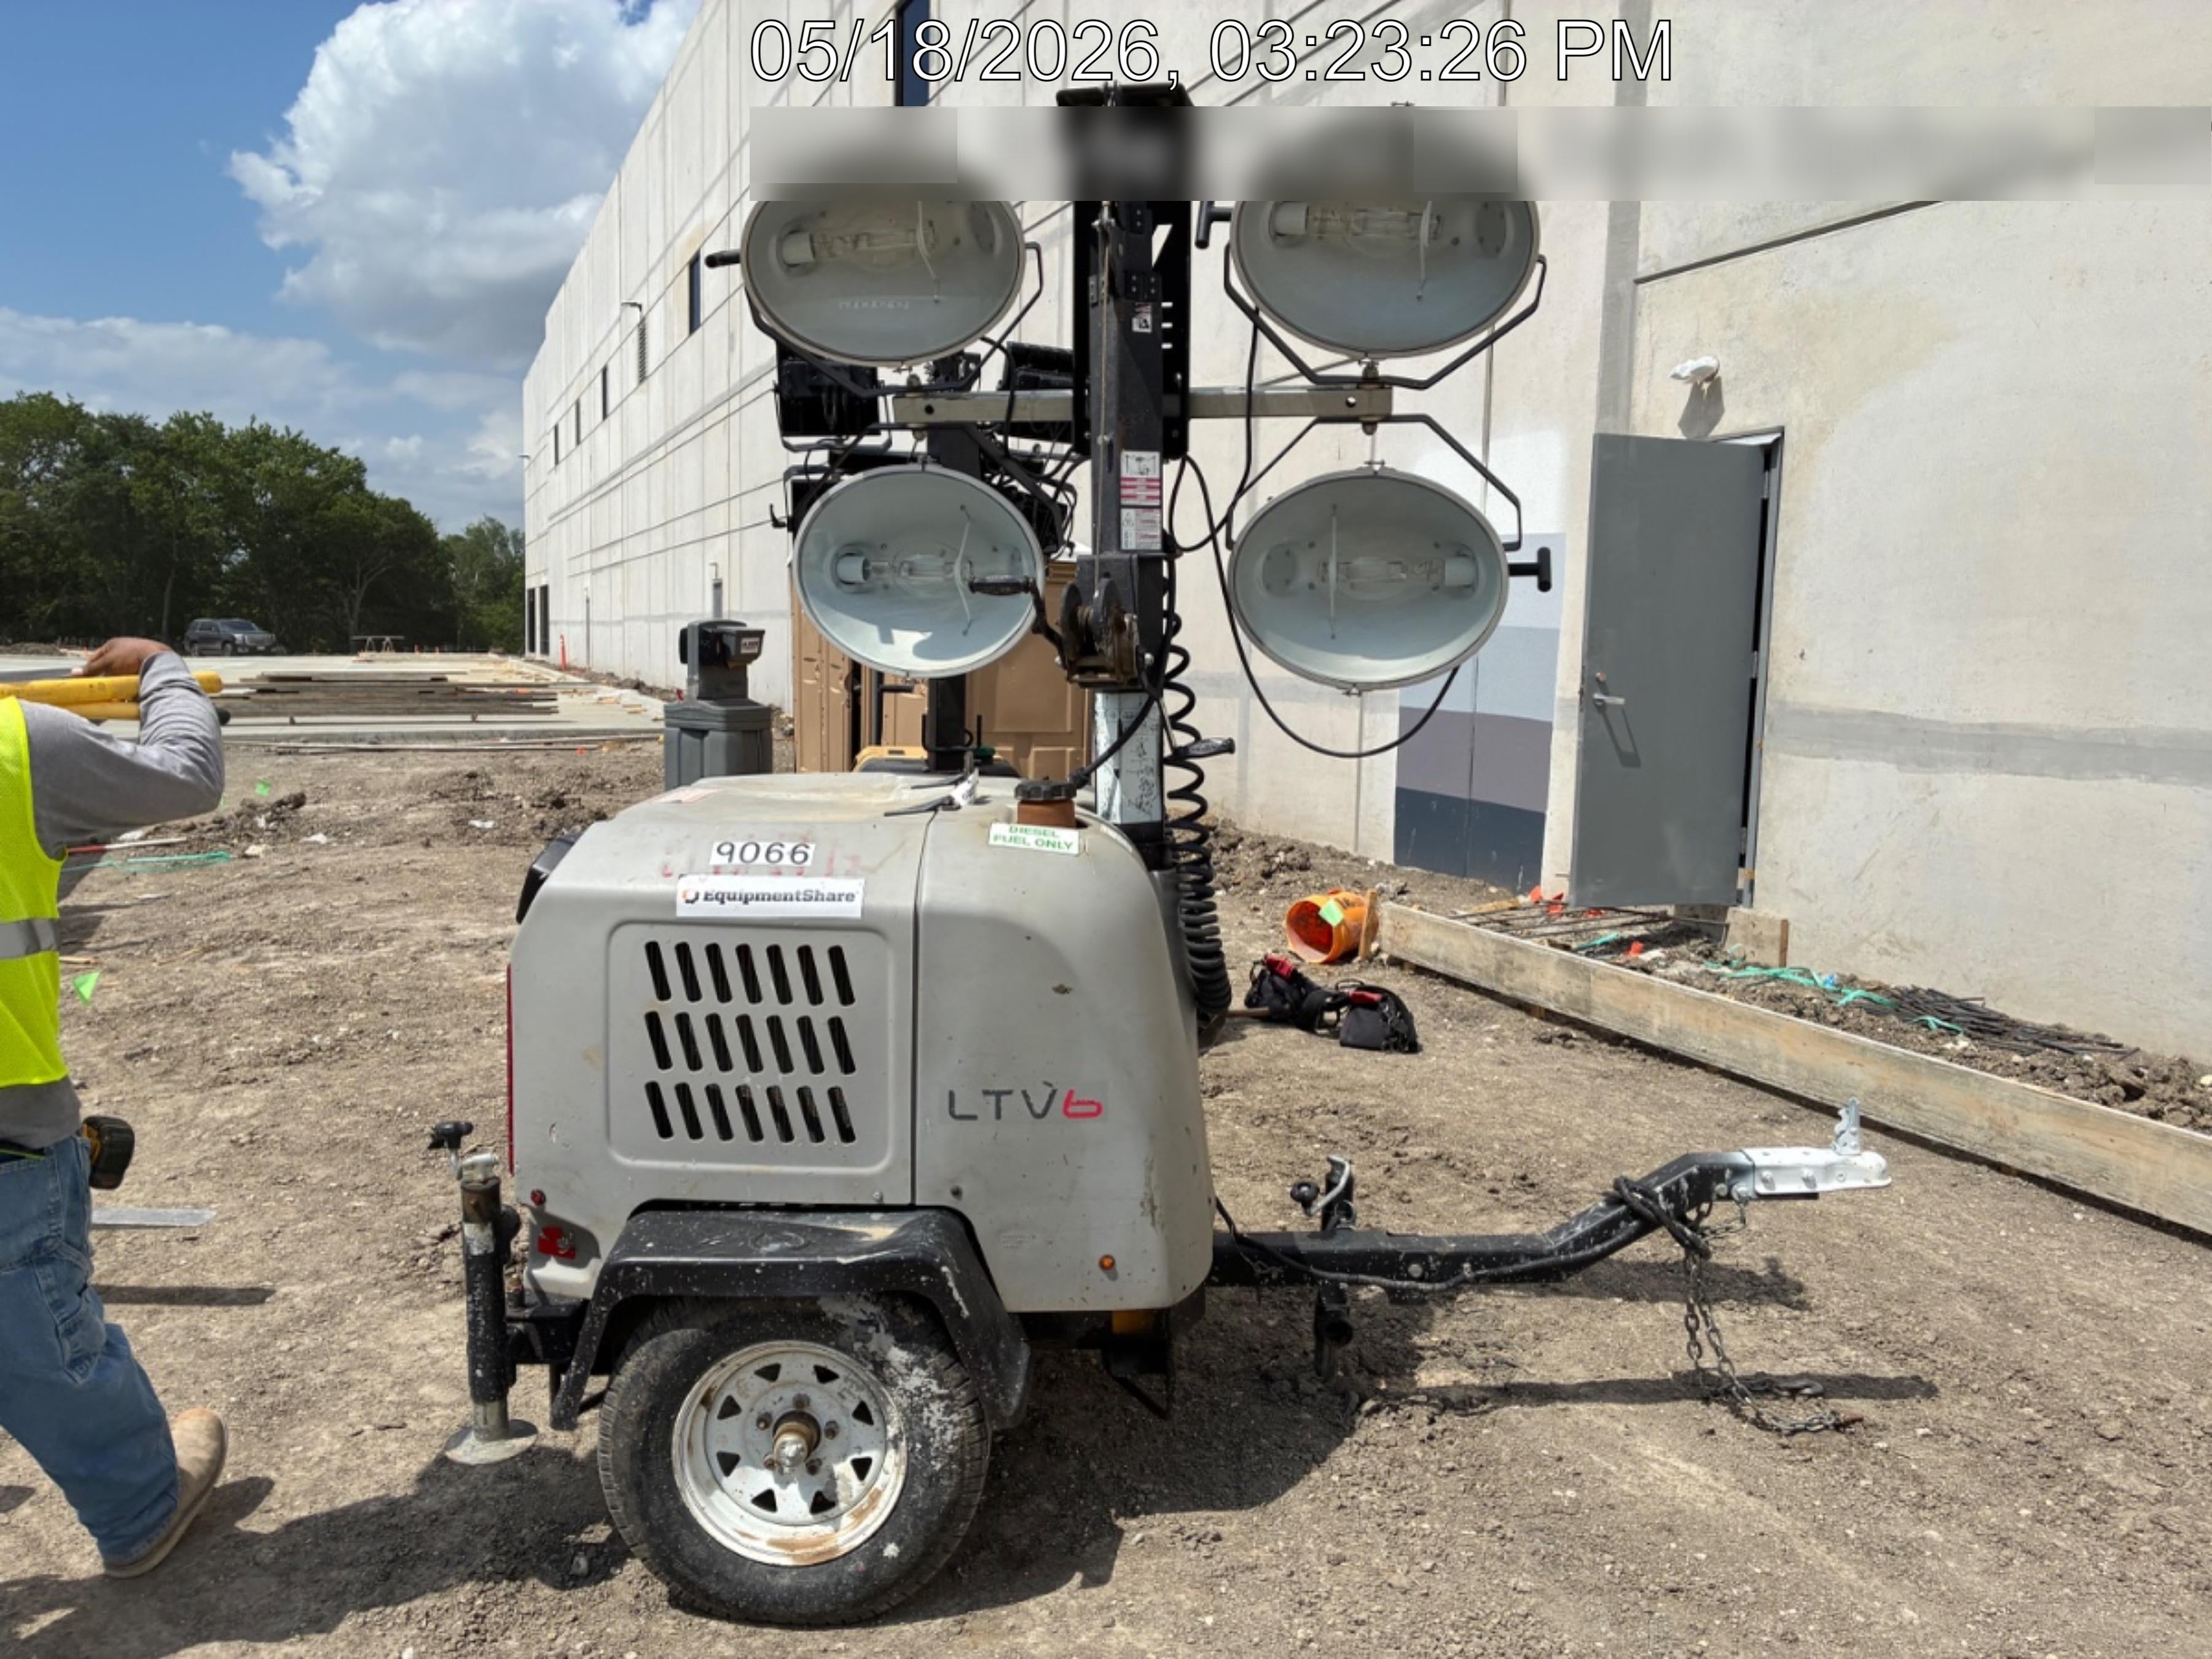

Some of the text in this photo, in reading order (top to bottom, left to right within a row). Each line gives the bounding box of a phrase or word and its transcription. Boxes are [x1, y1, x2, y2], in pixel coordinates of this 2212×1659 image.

[1009, 825, 1058, 837] DIESEL
[993, 834, 1073, 850] FUEL ONLY
[716, 842, 809, 865] 9066
[703, 889, 856, 905] EquipmentShare
